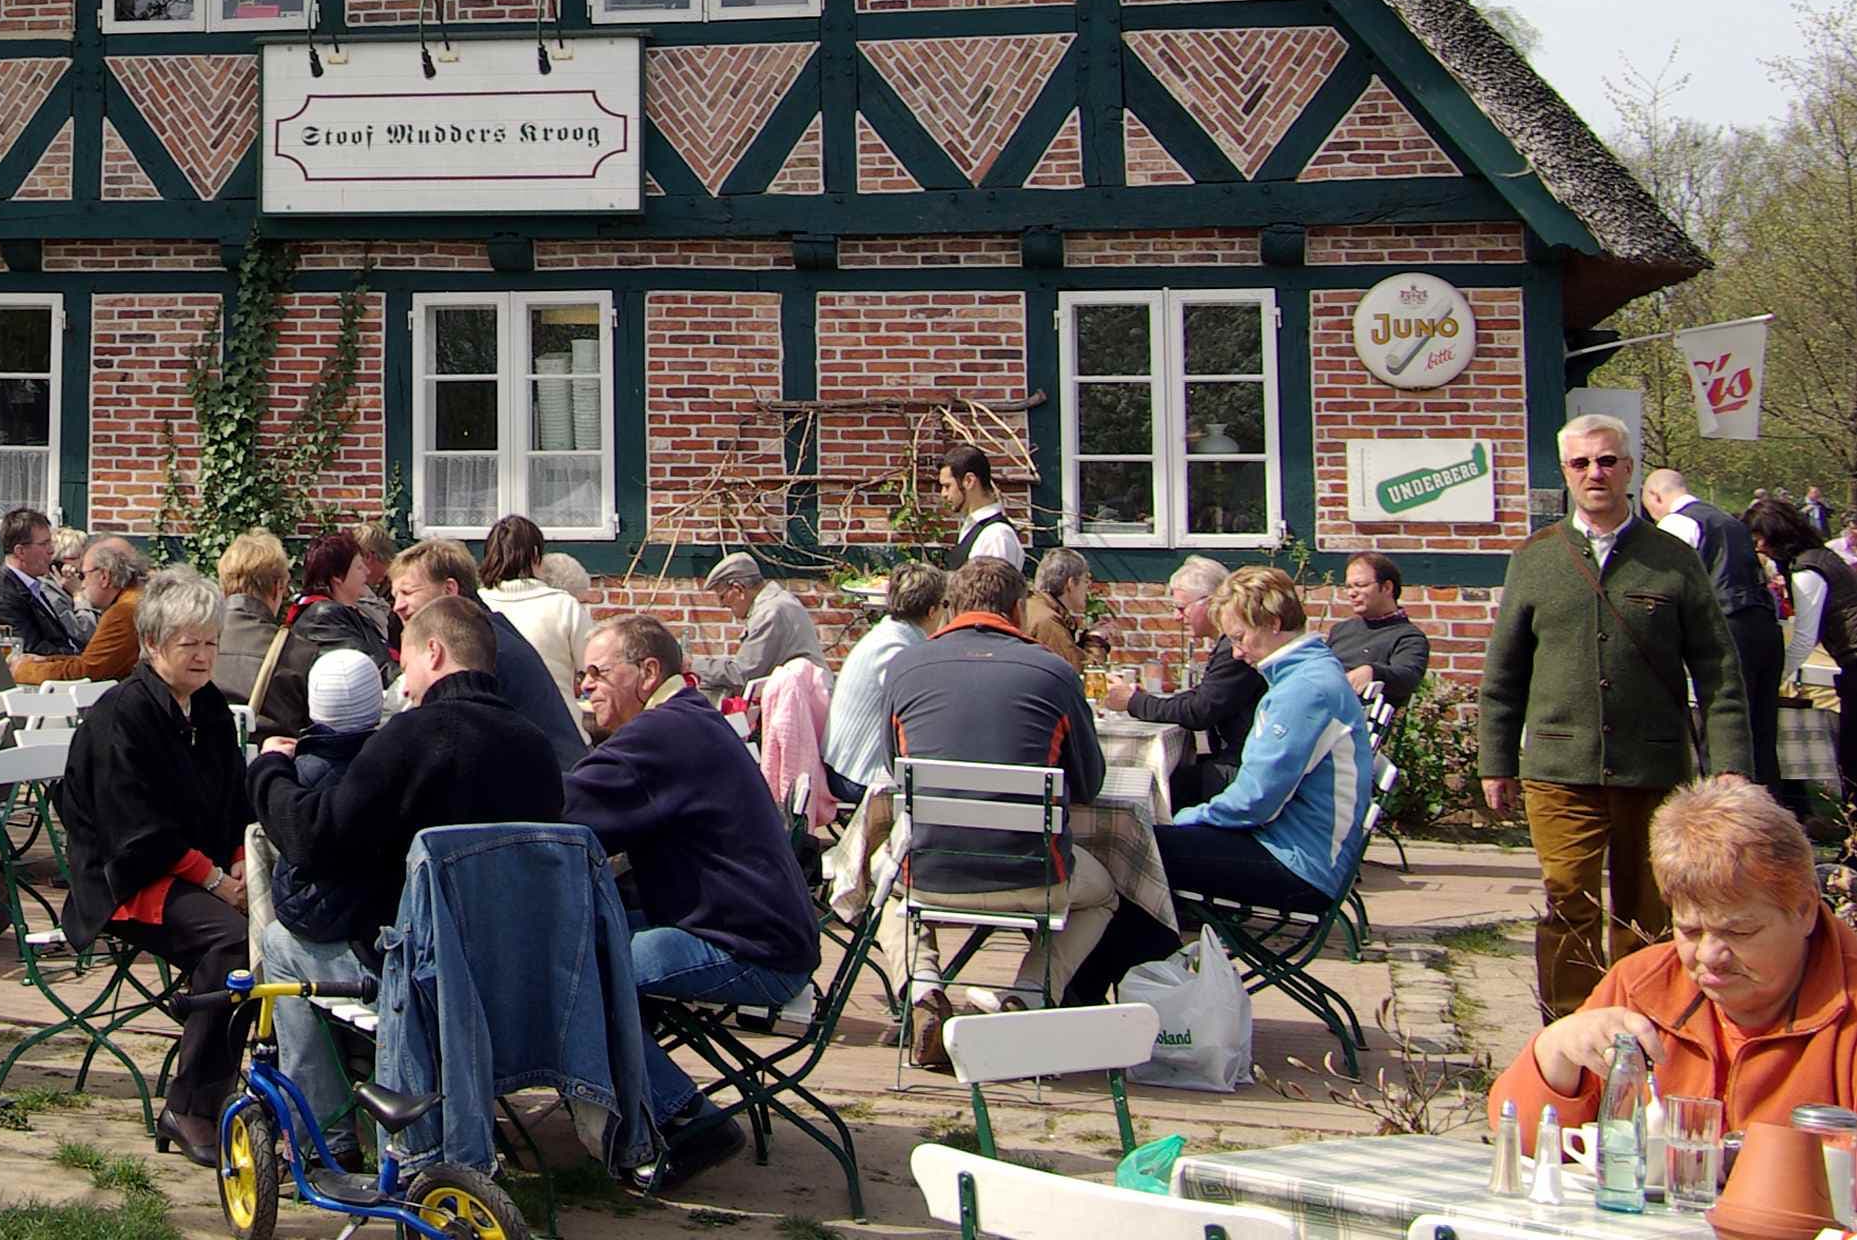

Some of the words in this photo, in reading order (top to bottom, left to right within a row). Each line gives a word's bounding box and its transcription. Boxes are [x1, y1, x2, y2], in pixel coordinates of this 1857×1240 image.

[386, 122, 507, 145] Mudders
[520, 121, 601, 148] Kroog
[1370, 313, 1459, 346] JUNO
[1424, 345, 1454, 371] bitte
[1386, 461, 1480, 504] UNDERBERG
